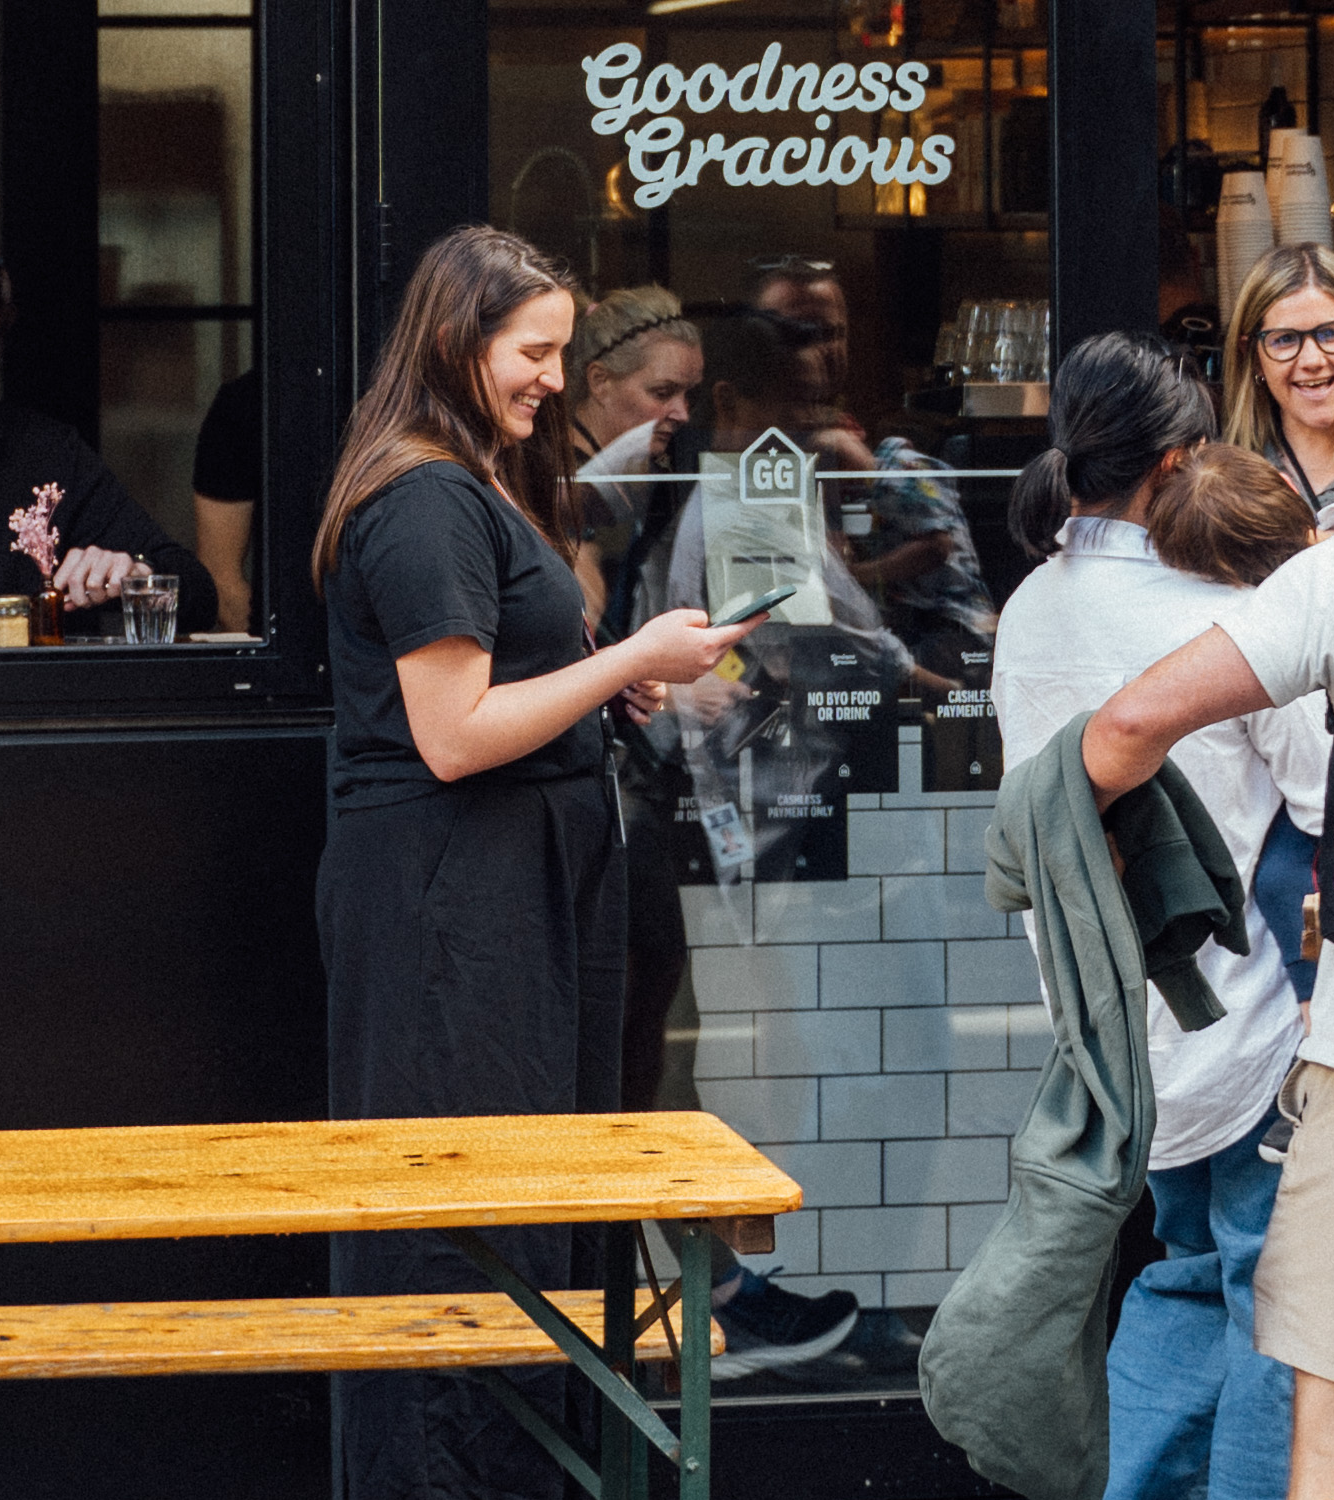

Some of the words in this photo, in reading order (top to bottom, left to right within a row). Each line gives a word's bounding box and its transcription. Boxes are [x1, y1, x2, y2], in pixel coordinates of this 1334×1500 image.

[581, 41, 930, 136] Goodness
[624, 113, 956, 210] Gracious
[752, 458, 795, 491] GG
[807, 691, 825, 707] NO
[826, 690, 849, 706] BYO
[850, 690, 881, 706] FOOD
[947, 689, 993, 704] CASHLES
[817, 706, 834, 722] OR
[835, 705, 871, 721] DRINK
[937, 704, 985, 719] PAYMENT
[768, 806, 809, 819] PAYMENT
[810, 804, 834, 818] ONLY
